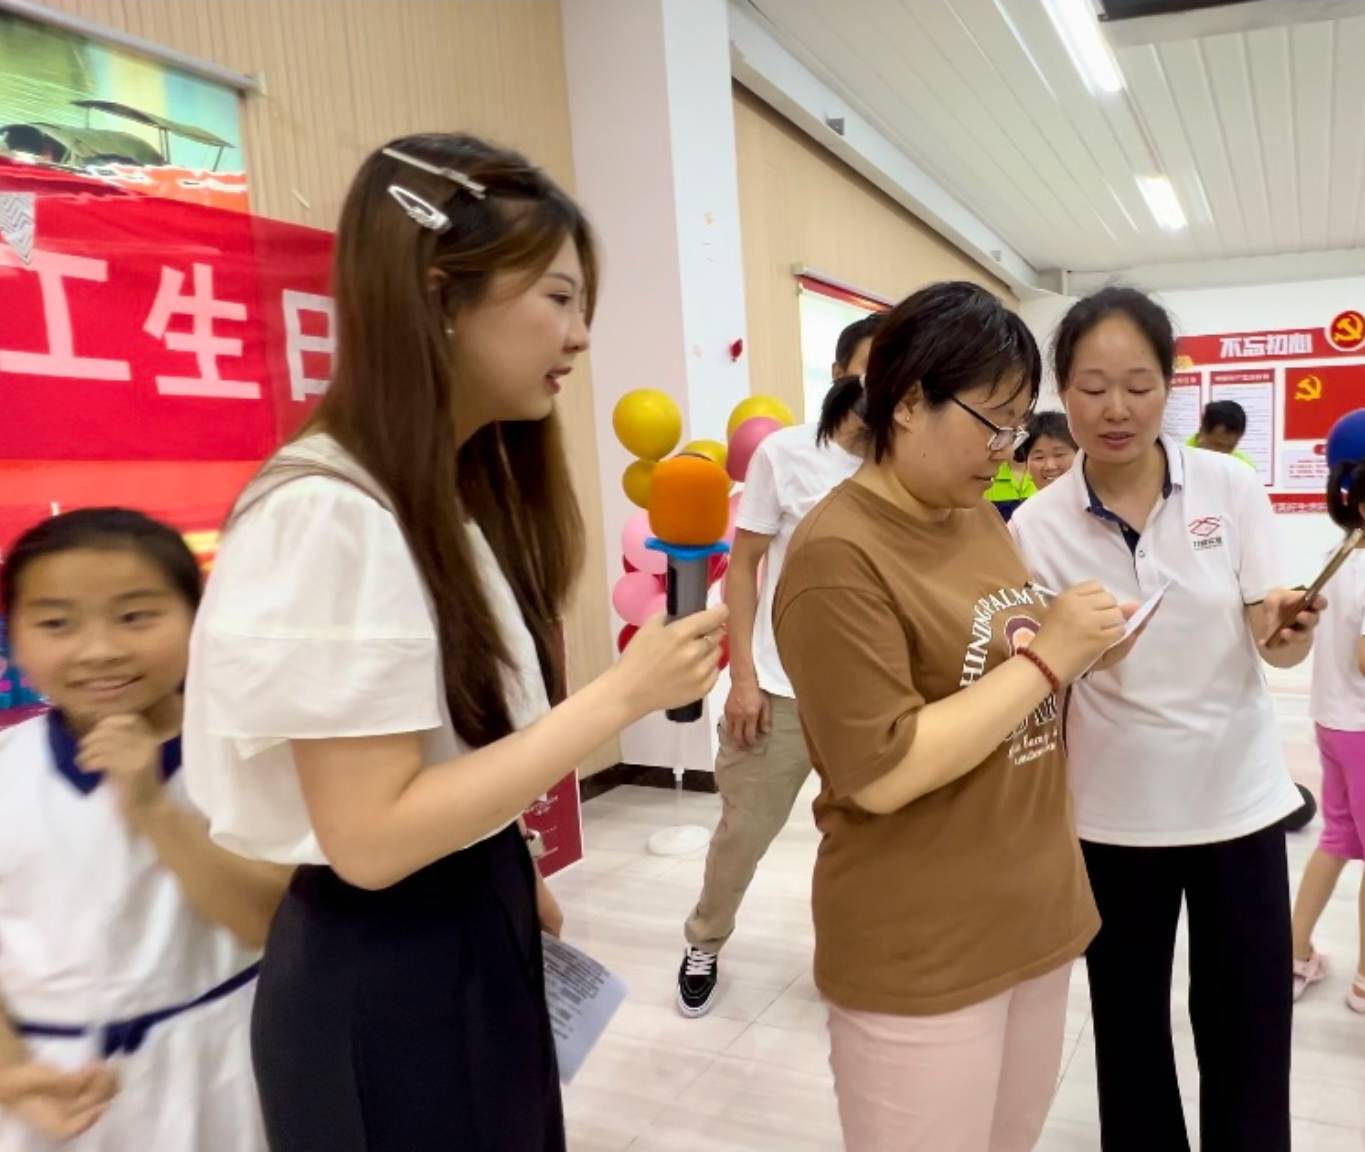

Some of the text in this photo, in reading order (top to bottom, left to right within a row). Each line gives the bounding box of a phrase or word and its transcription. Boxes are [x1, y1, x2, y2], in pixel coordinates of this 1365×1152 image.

[1220, 333, 1313, 359] 不忘初心
[960, 604, 992, 687] HINING
